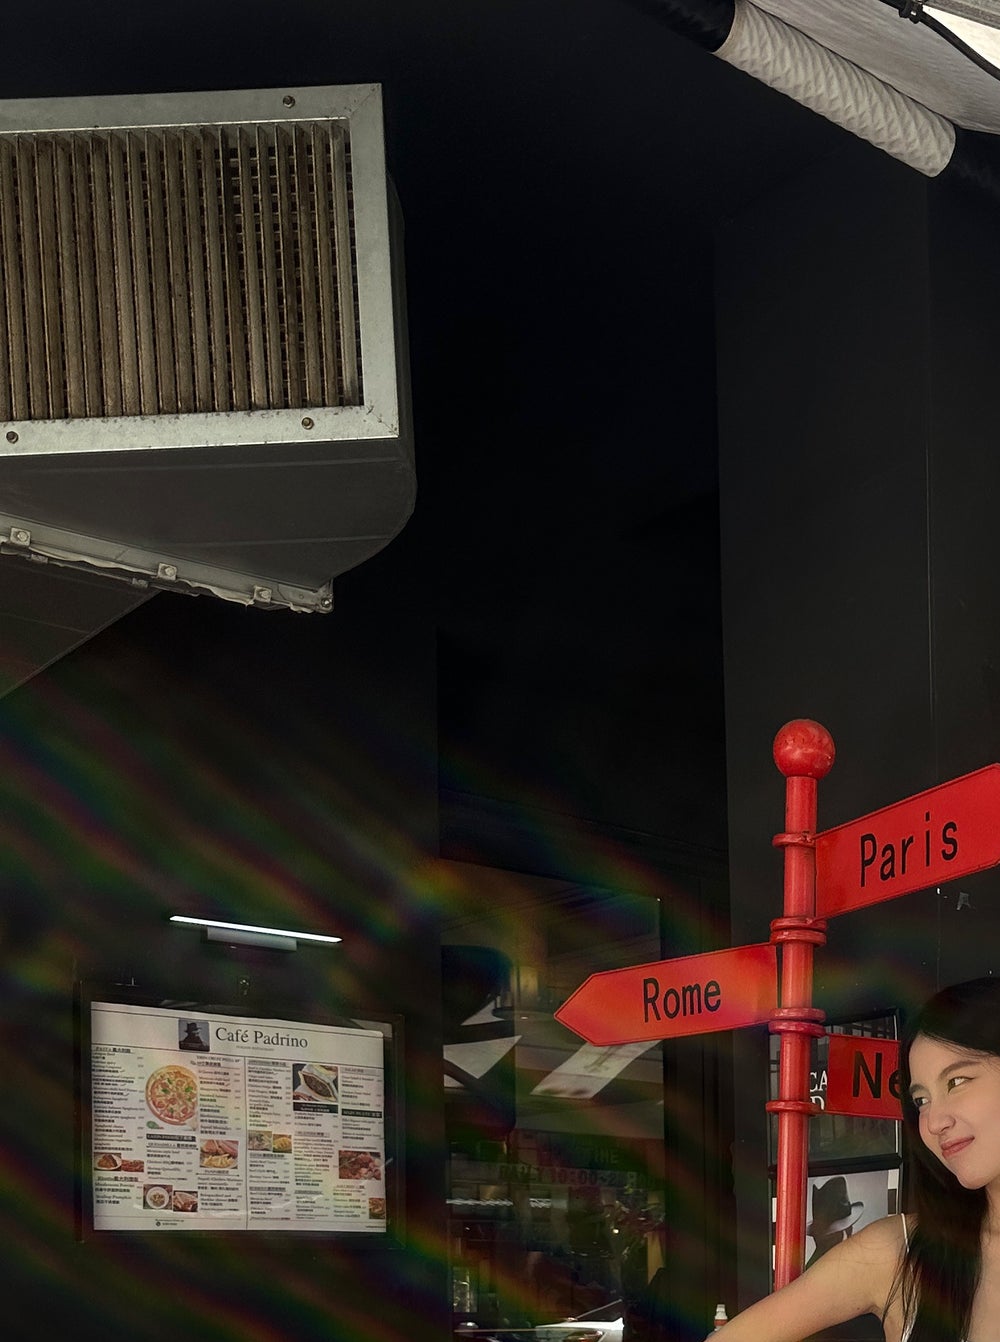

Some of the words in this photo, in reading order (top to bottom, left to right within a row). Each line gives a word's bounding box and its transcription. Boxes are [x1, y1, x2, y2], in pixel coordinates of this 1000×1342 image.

[859, 811, 959, 888] Paris
[642, 976, 722, 1023] Rome
[215, 1026, 249, 1043] Café
[254, 1030, 308, 1049] Padrino
[852, 1050, 903, 1100] Ne
